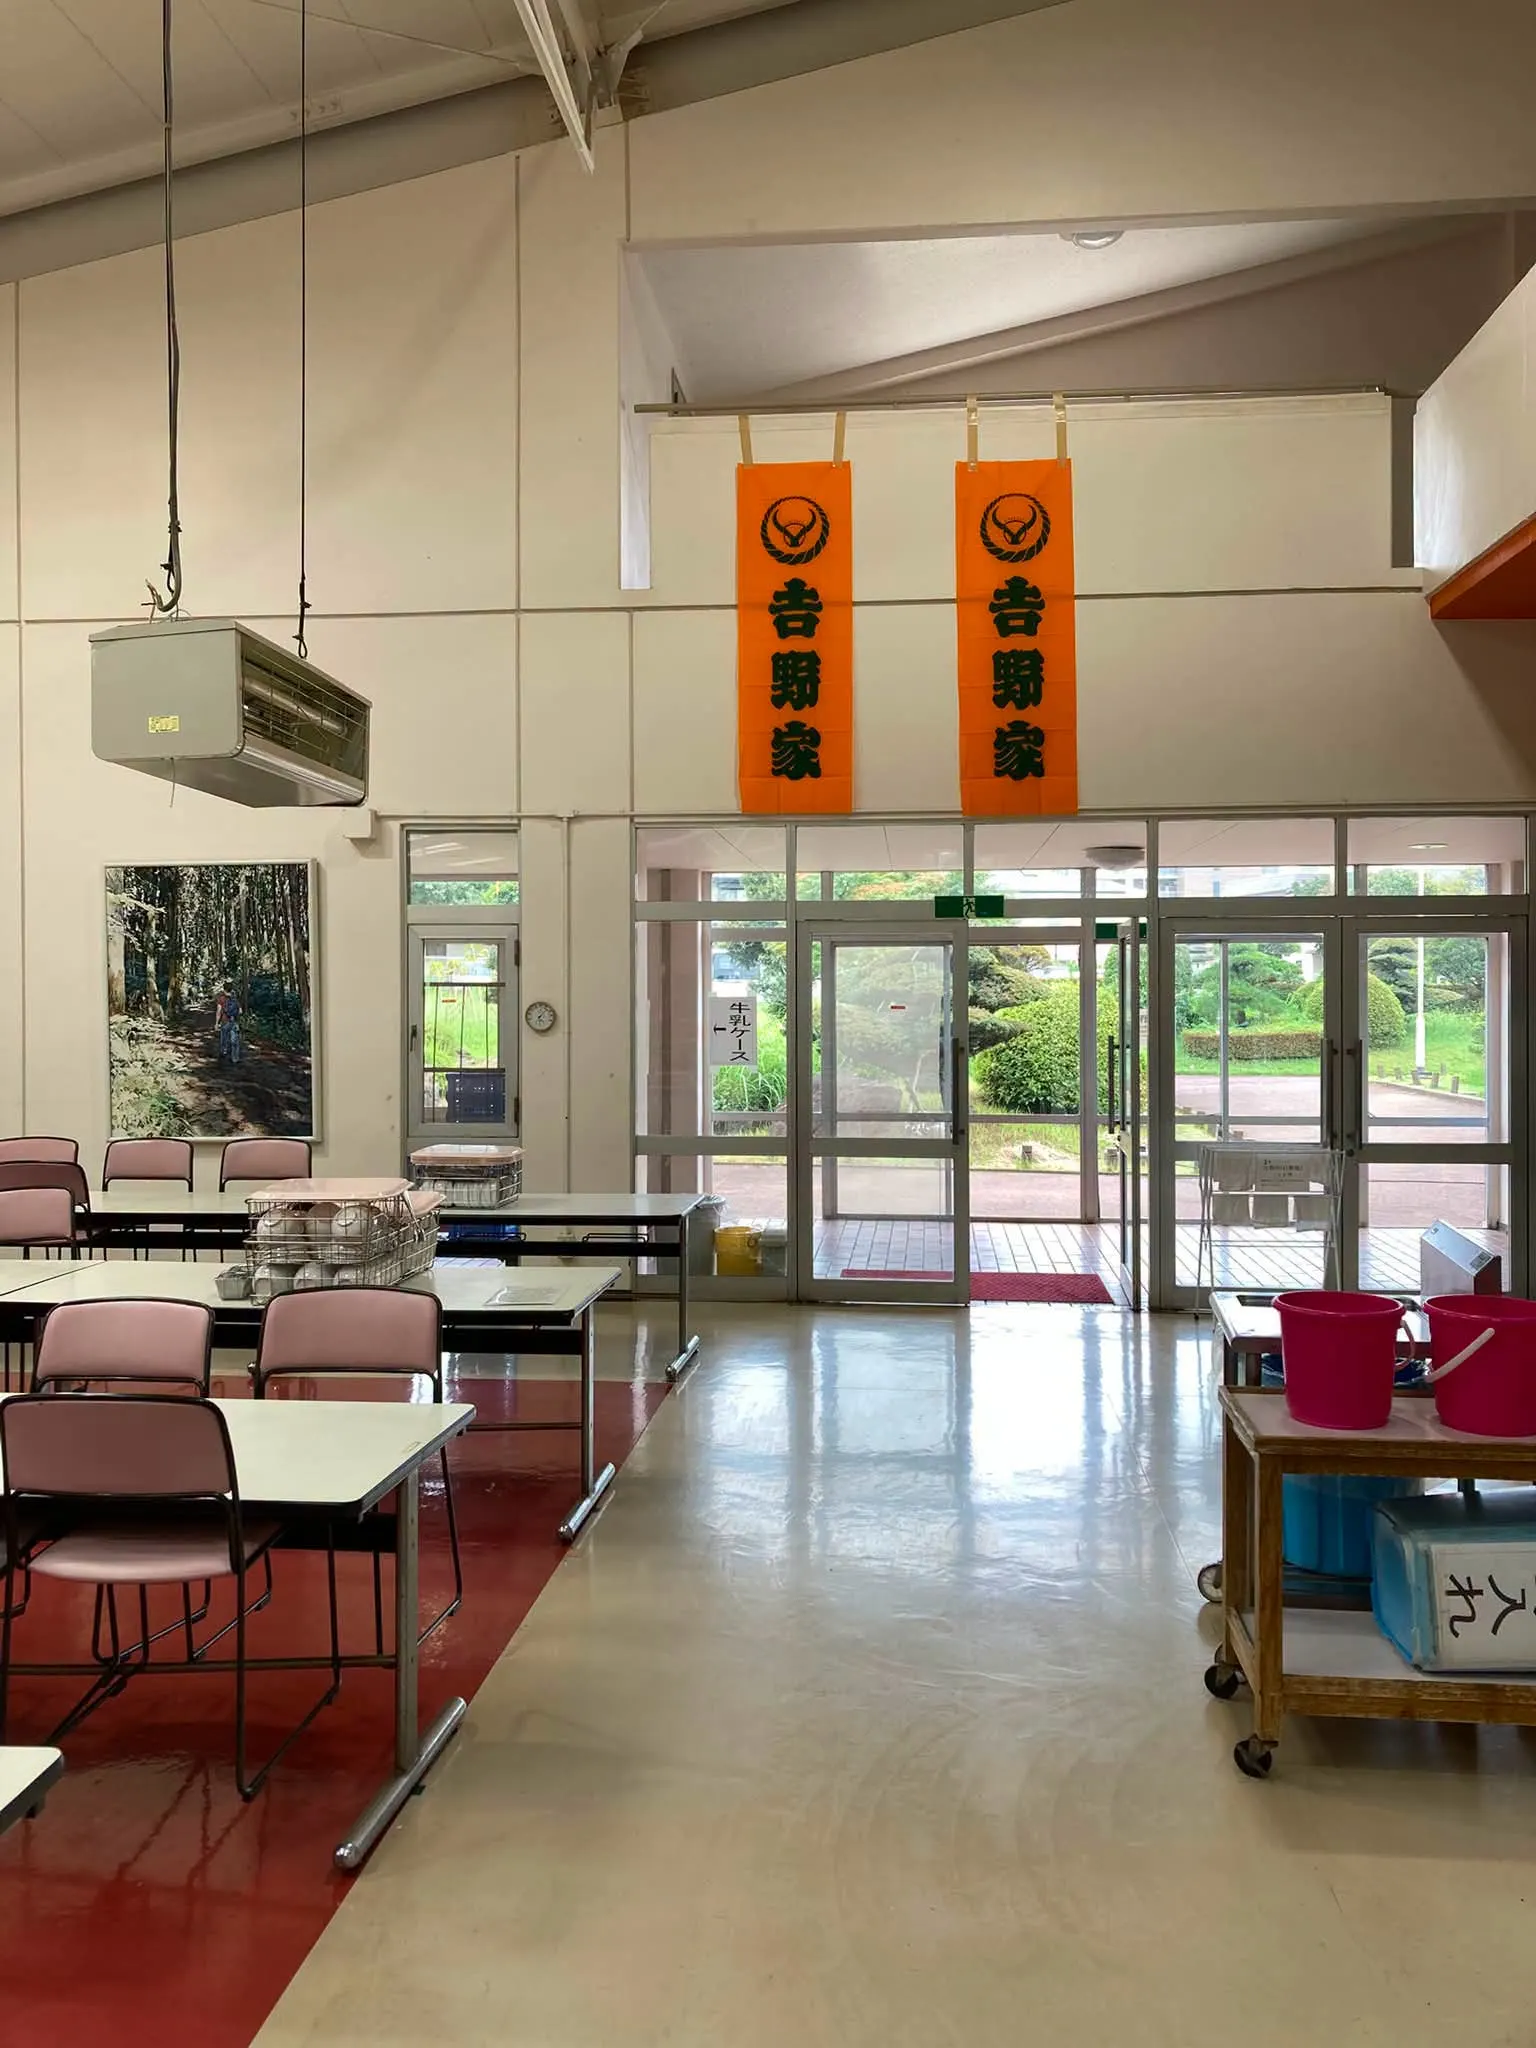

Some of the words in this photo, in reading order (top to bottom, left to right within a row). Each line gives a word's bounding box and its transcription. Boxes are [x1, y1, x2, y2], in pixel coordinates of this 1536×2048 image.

[728, 1002, 752, 1062] 牛乳ケース
[1445, 1573, 1536, 1639] 入れ
